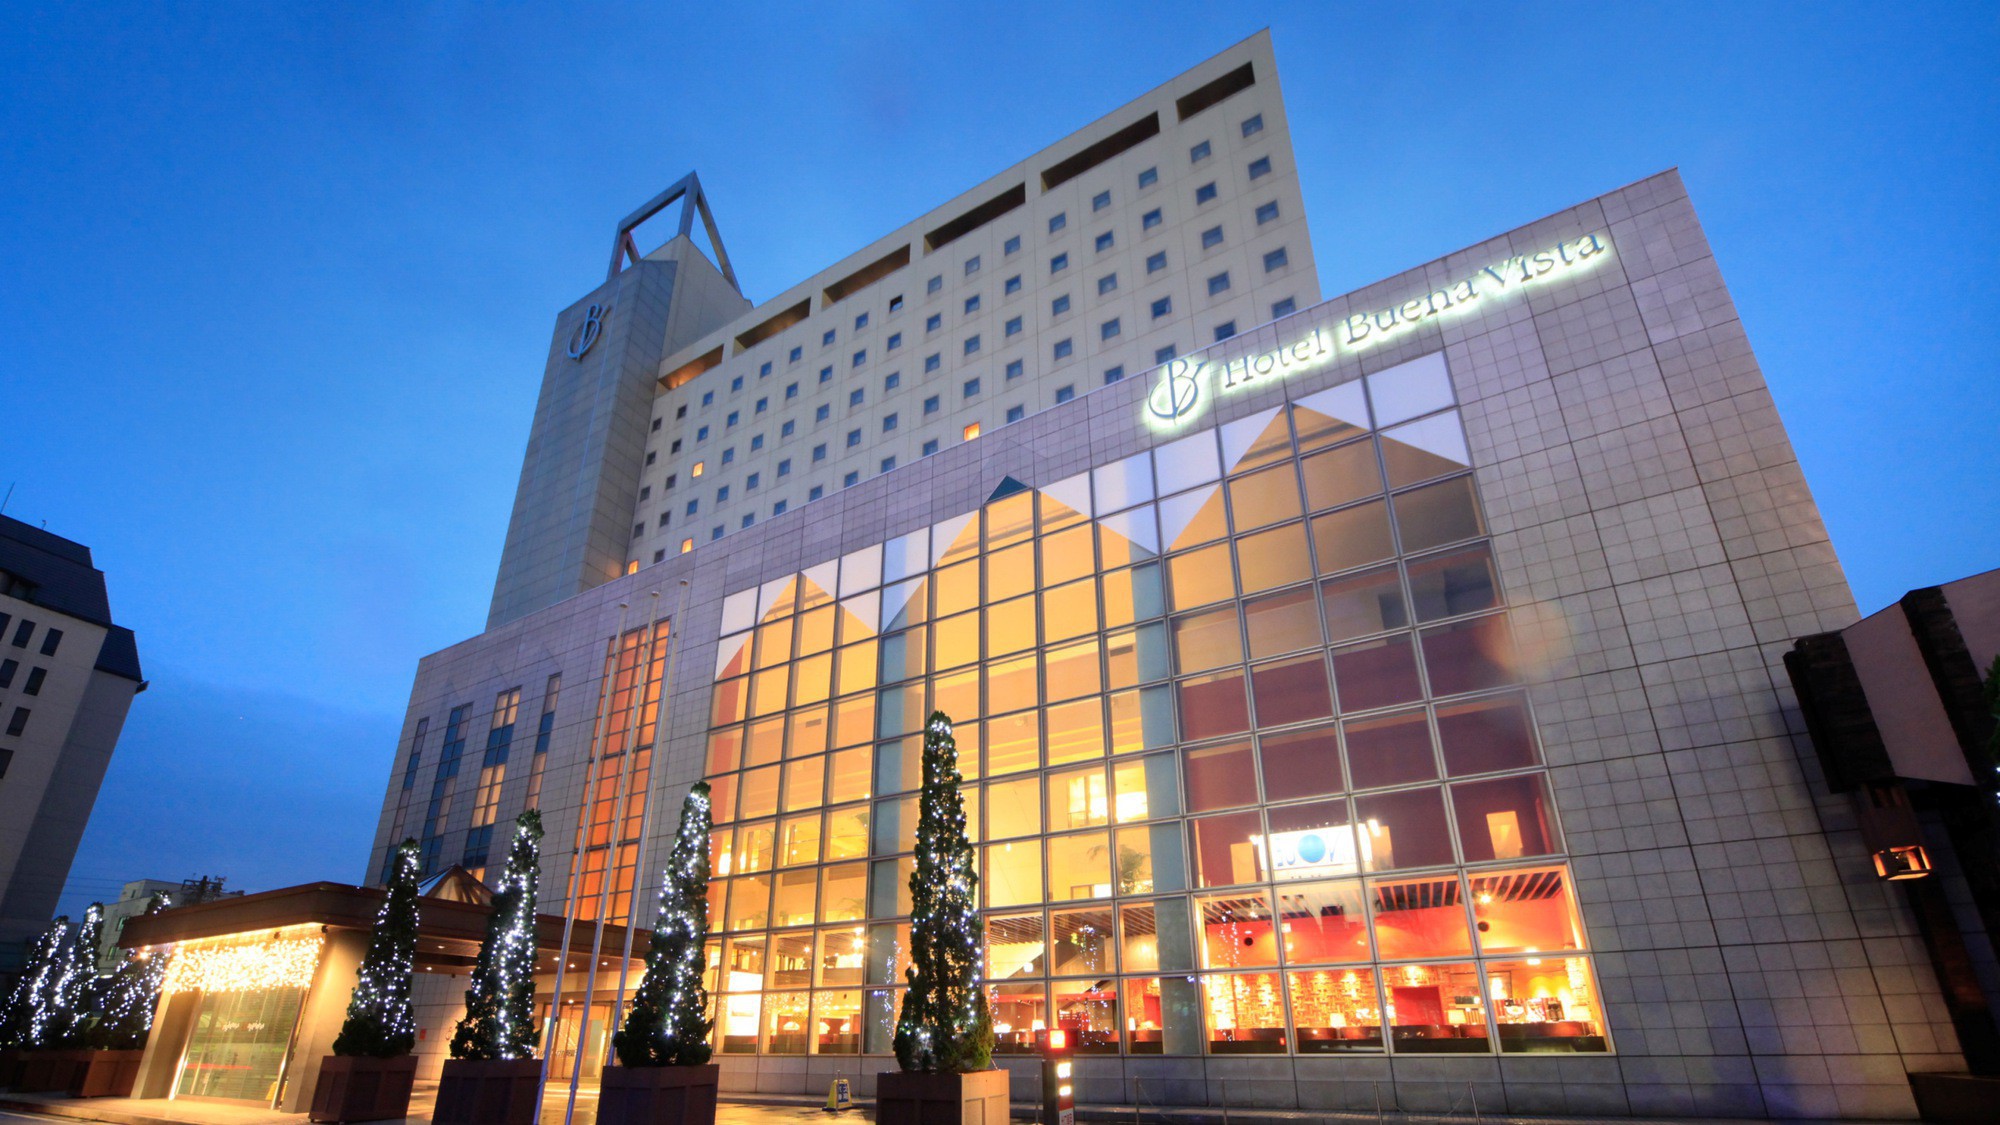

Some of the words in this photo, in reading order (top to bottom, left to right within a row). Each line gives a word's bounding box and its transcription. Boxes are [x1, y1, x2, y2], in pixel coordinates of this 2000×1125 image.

[1222, 328, 1326, 388] Hotel
[1343, 278, 1480, 345] Buena
[1480, 233, 1605, 289] Vista
